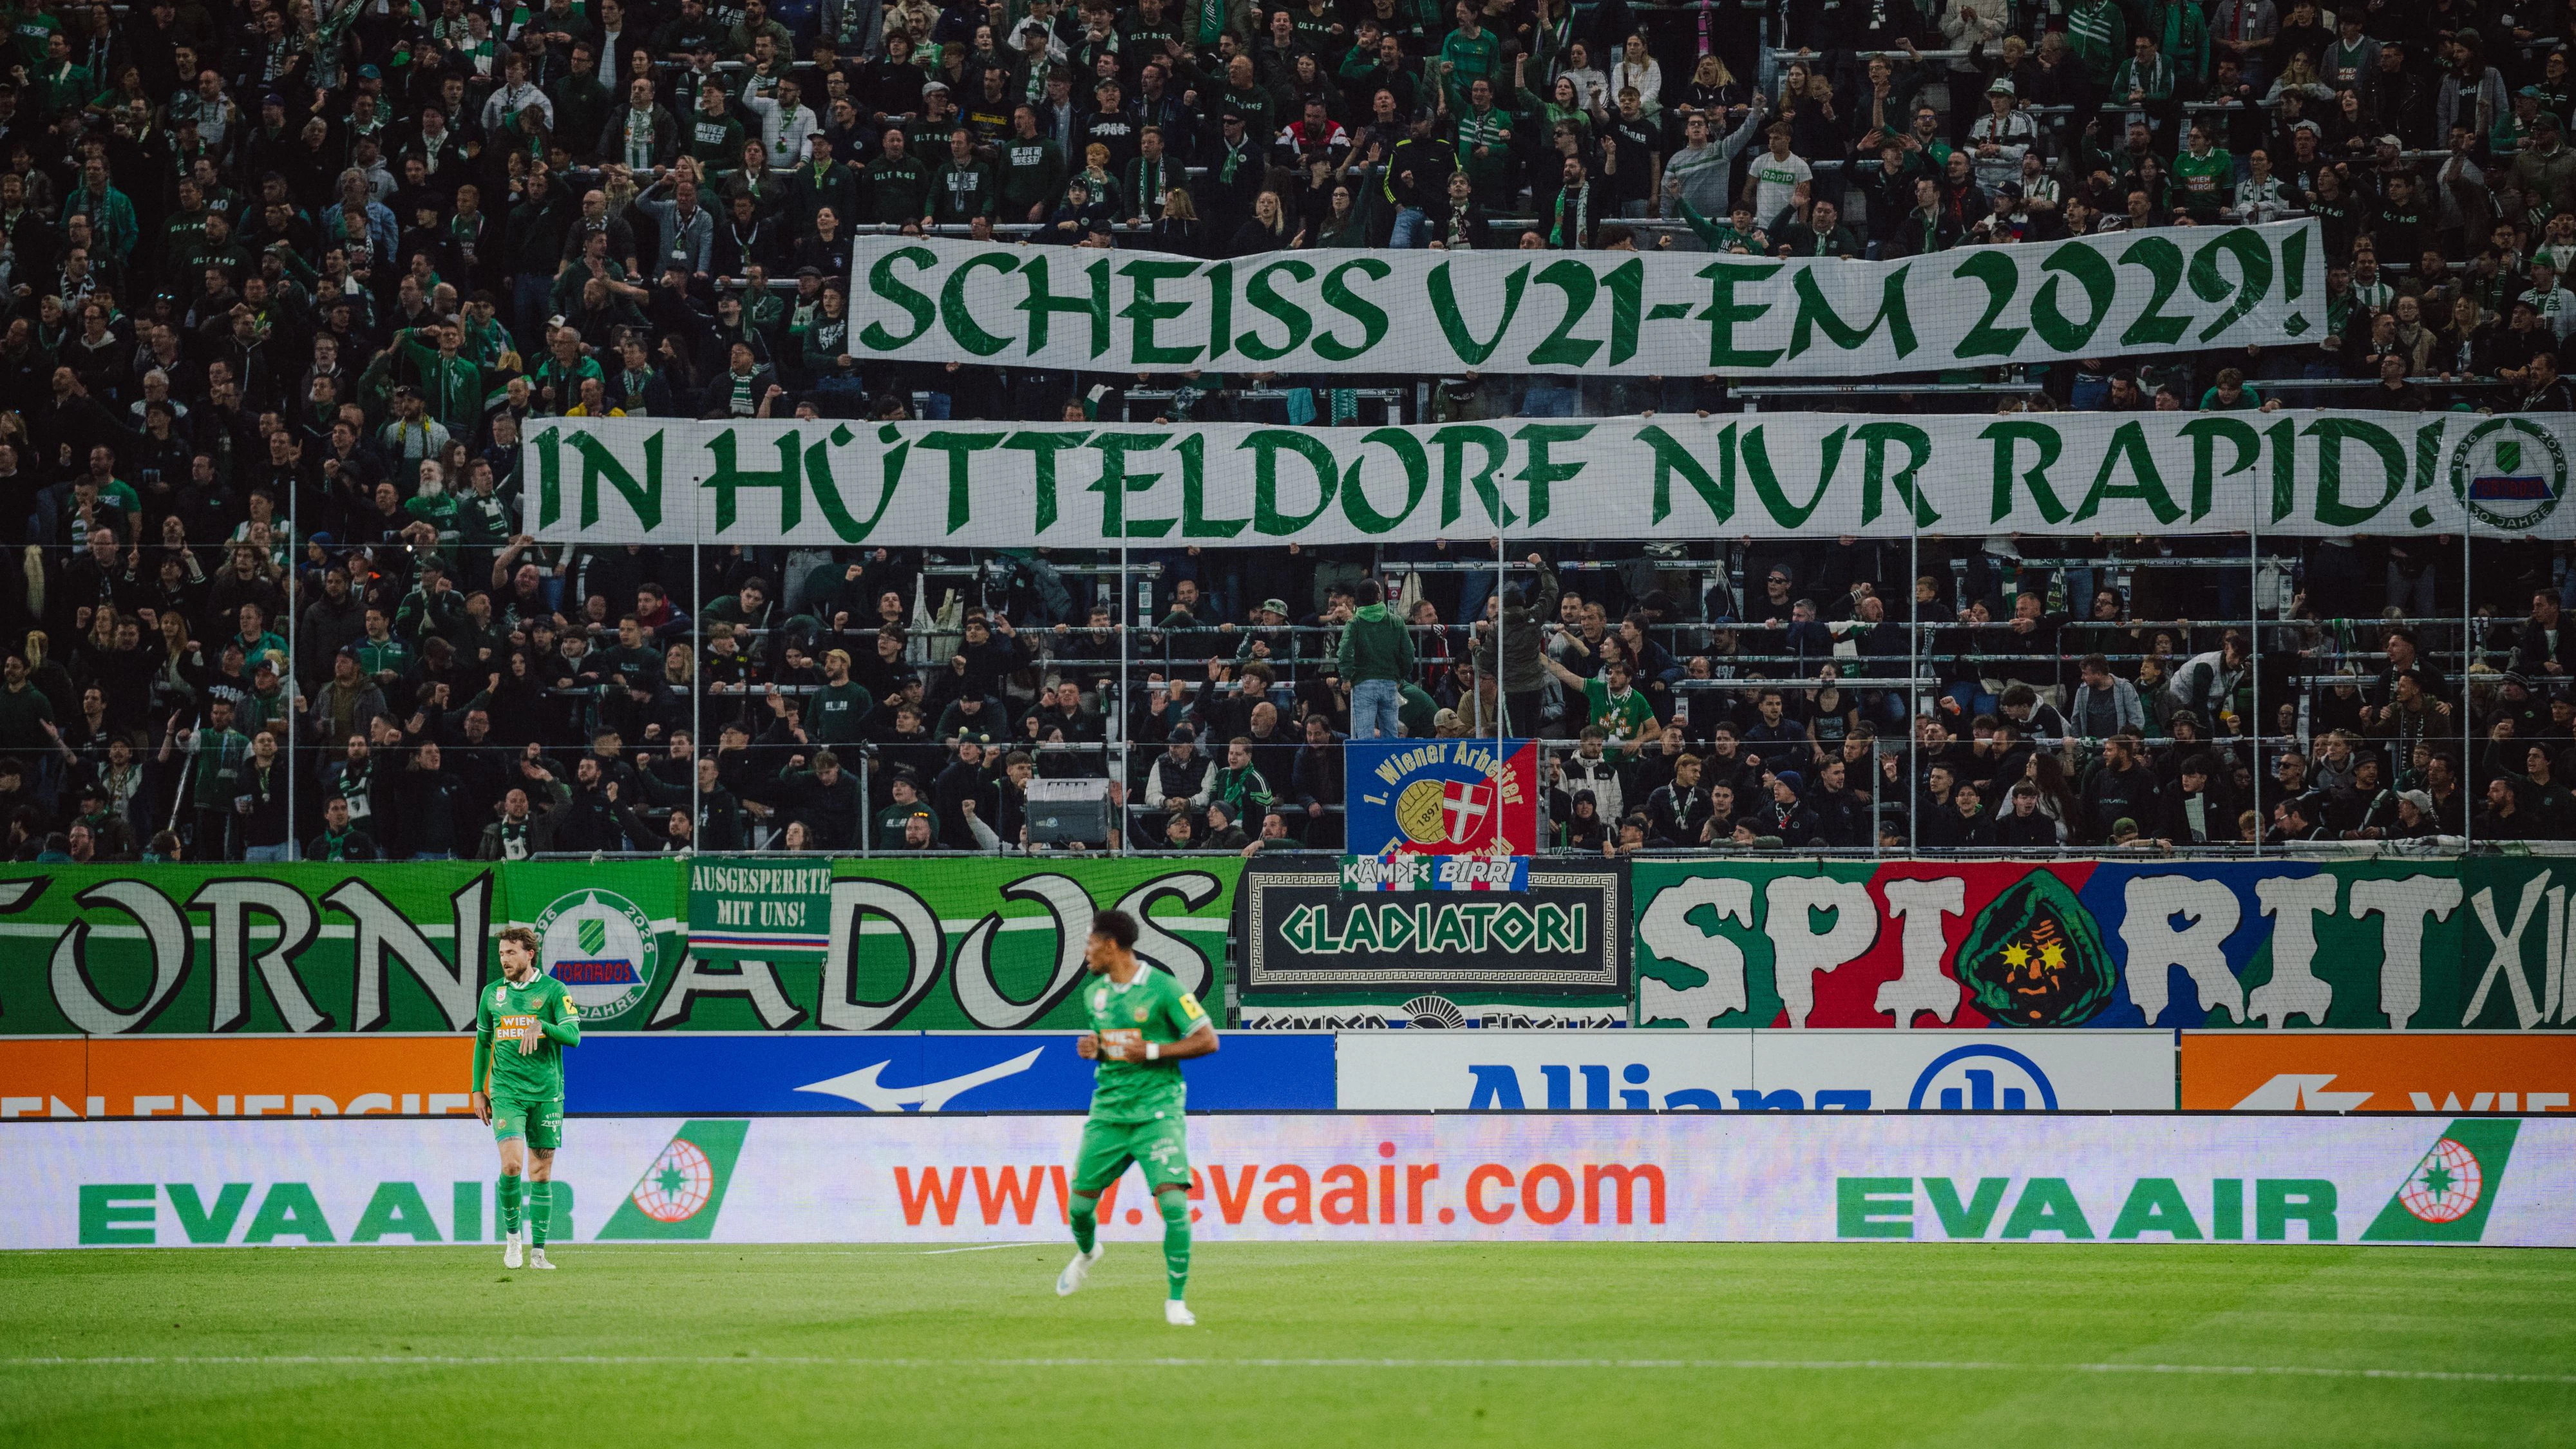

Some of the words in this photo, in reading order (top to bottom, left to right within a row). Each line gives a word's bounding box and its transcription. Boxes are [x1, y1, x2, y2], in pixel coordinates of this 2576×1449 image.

[2459, 84, 2477, 97] apid
[695, 131, 724, 144] WEST
[1012, 155, 1041, 166] WEST
[1763, 169, 1794, 183] RAPID
[861, 247, 1393, 365] SCHEISS
[1427, 258, 1918, 368] U21-EM
[1951, 225, 2312, 359] 2029!
[2452, 433, 2477, 471] 1996
[2538, 432, 2566, 472] 2026
[535, 425, 664, 533] IN
[701, 422, 1598, 544] HÜTTELDORF
[1633, 421, 1942, 529] NUR
[1978, 416, 2445, 528] RAPID!
[2470, 506, 2490, 521] 30
[2496, 506, 2550, 528] JAHRE
[1374, 743, 1448, 786] Wiener
[1453, 741, 1524, 805] Arbeiter
[1363, 791, 1388, 806] 1.
[1416, 802, 1440, 827] 1897
[691, 865, 831, 895] AUSGESPERRTE
[1439, 860, 1519, 883] BIRRI
[717, 900, 753, 925] MIT
[760, 901, 806, 927] UNS!
[623, 905, 655, 953] 2026
[1280, 902, 1587, 954] GLADIATORI
[556, 962, 631, 983] TORNADOS
[578, 990, 638, 1018] JAHRE
[497, 1028, 546, 1038] ENER
[502, 1017, 536, 1027] WIEN
